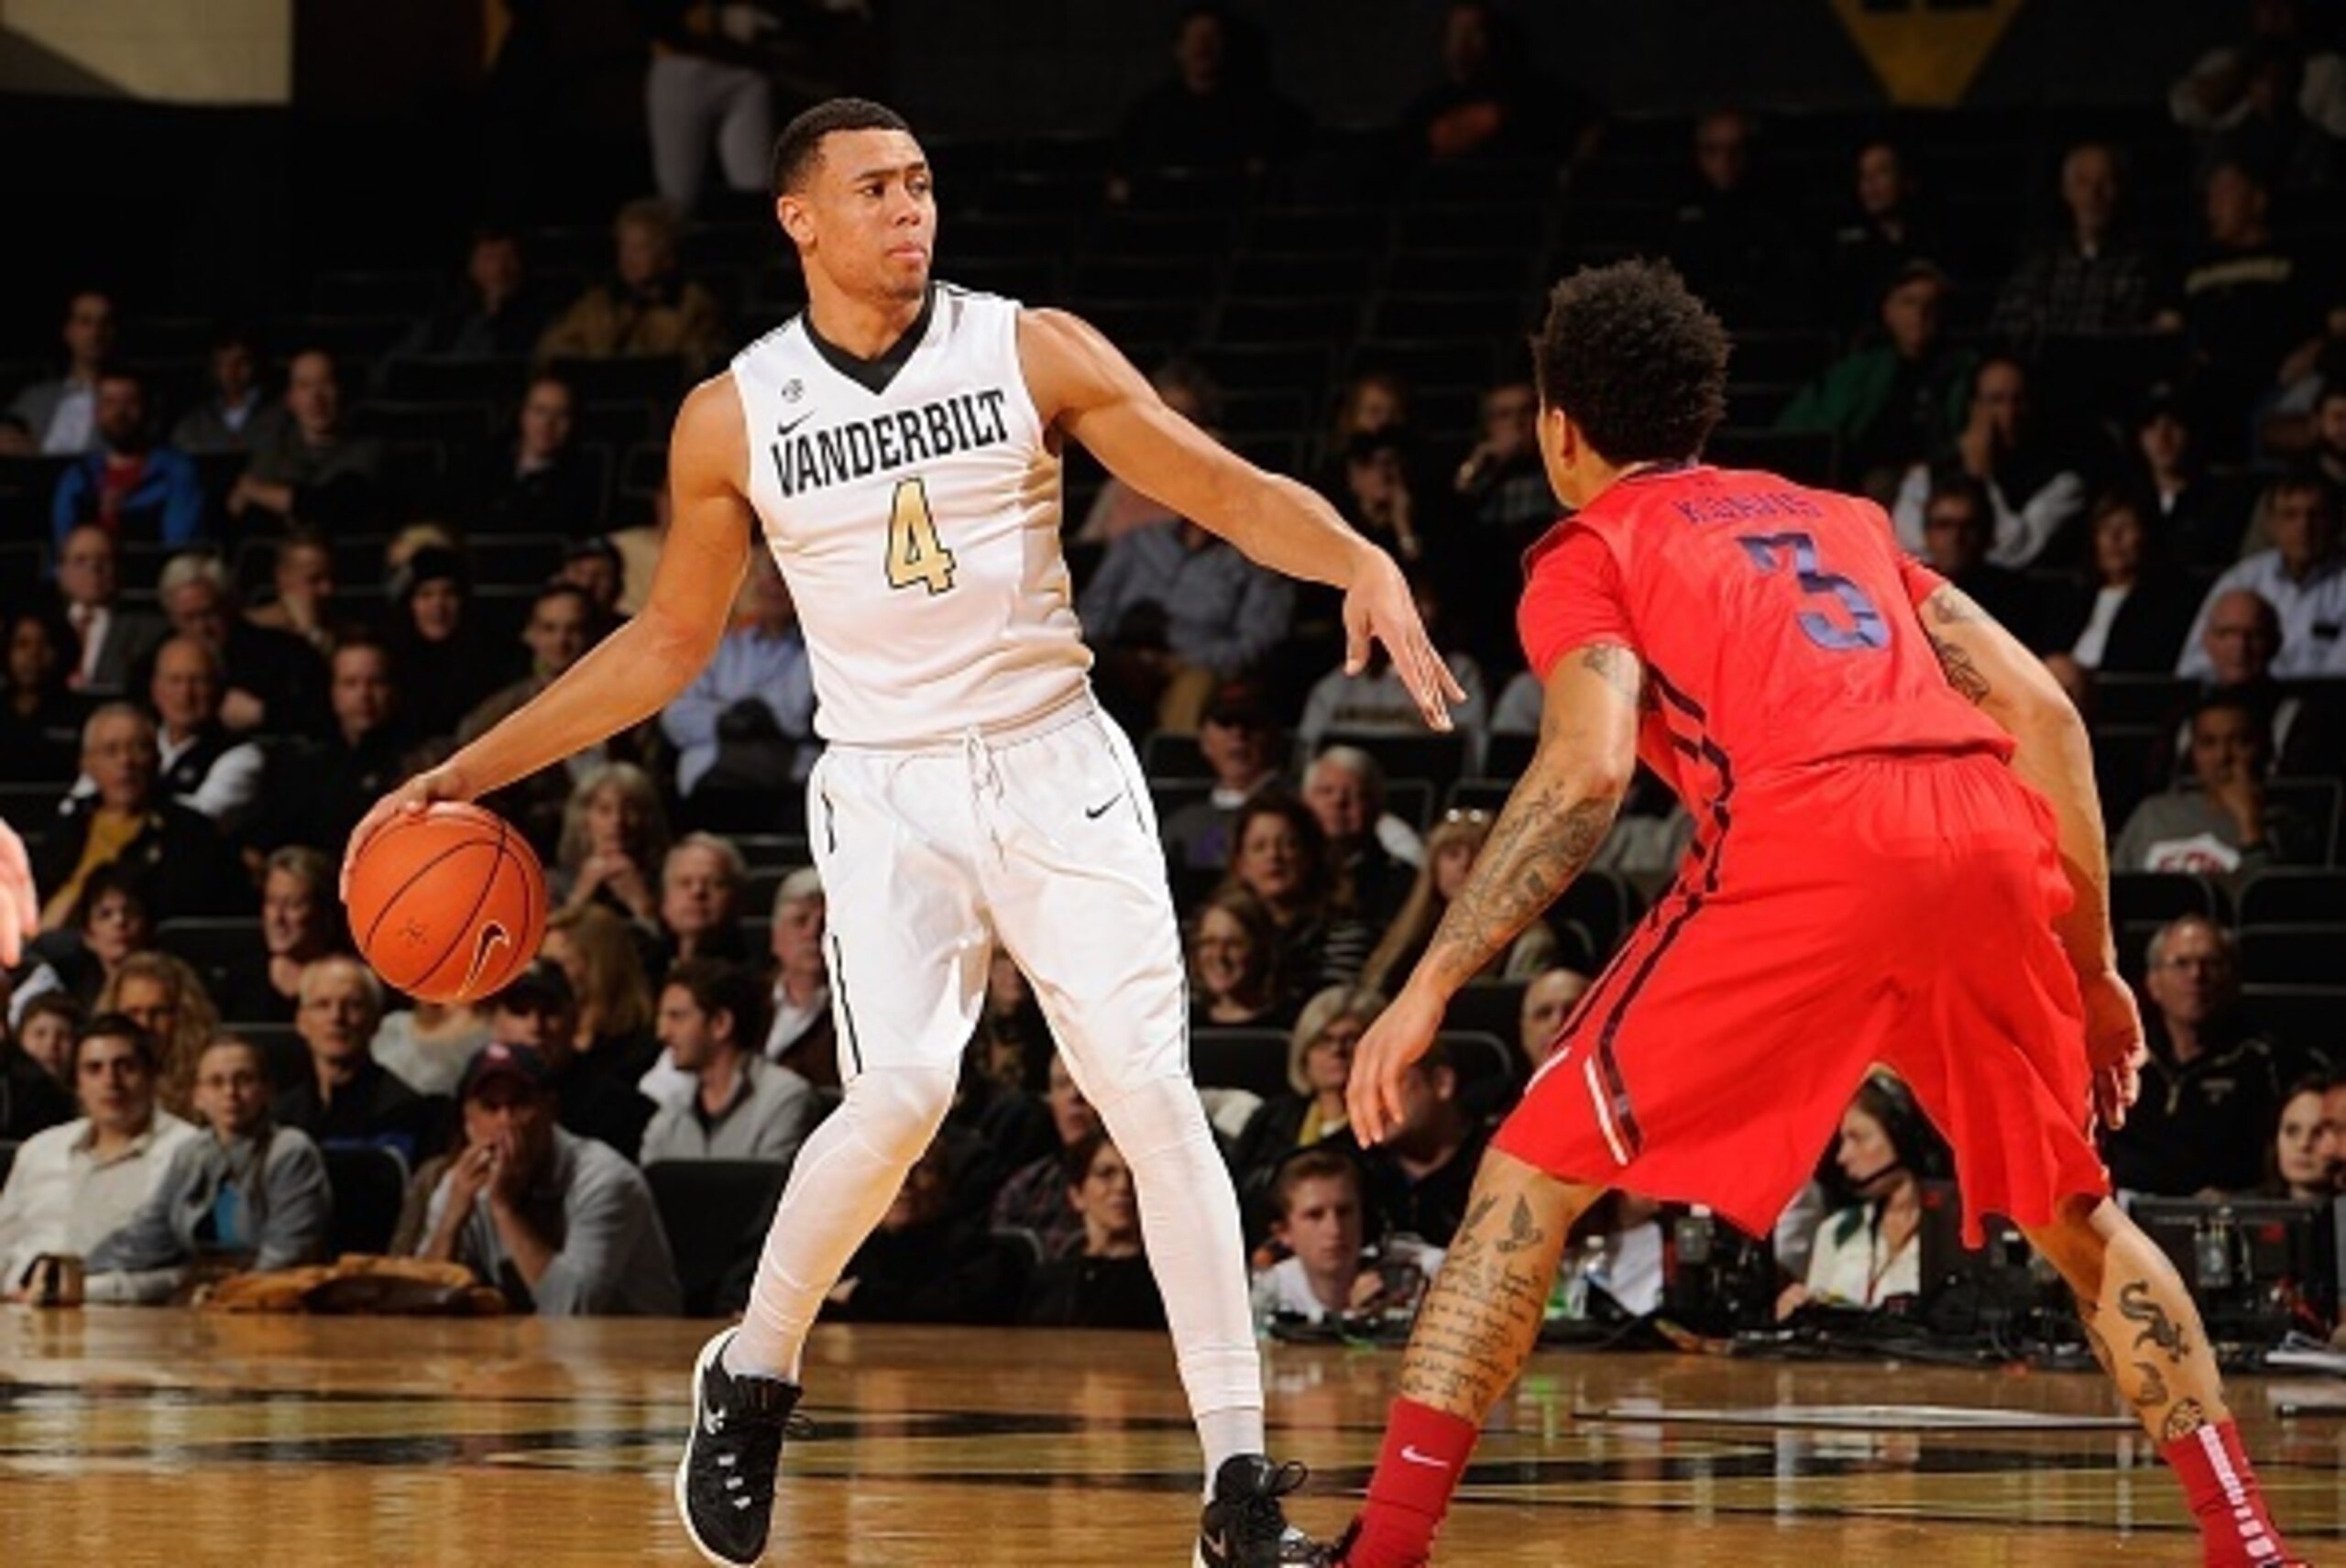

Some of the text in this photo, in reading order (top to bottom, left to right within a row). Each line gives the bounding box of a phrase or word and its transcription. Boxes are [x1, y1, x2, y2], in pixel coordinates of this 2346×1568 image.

[771, 389, 1008, 498] VANDERBILT
[885, 477, 956, 596] 4
[1736, 532, 1890, 652] 3
